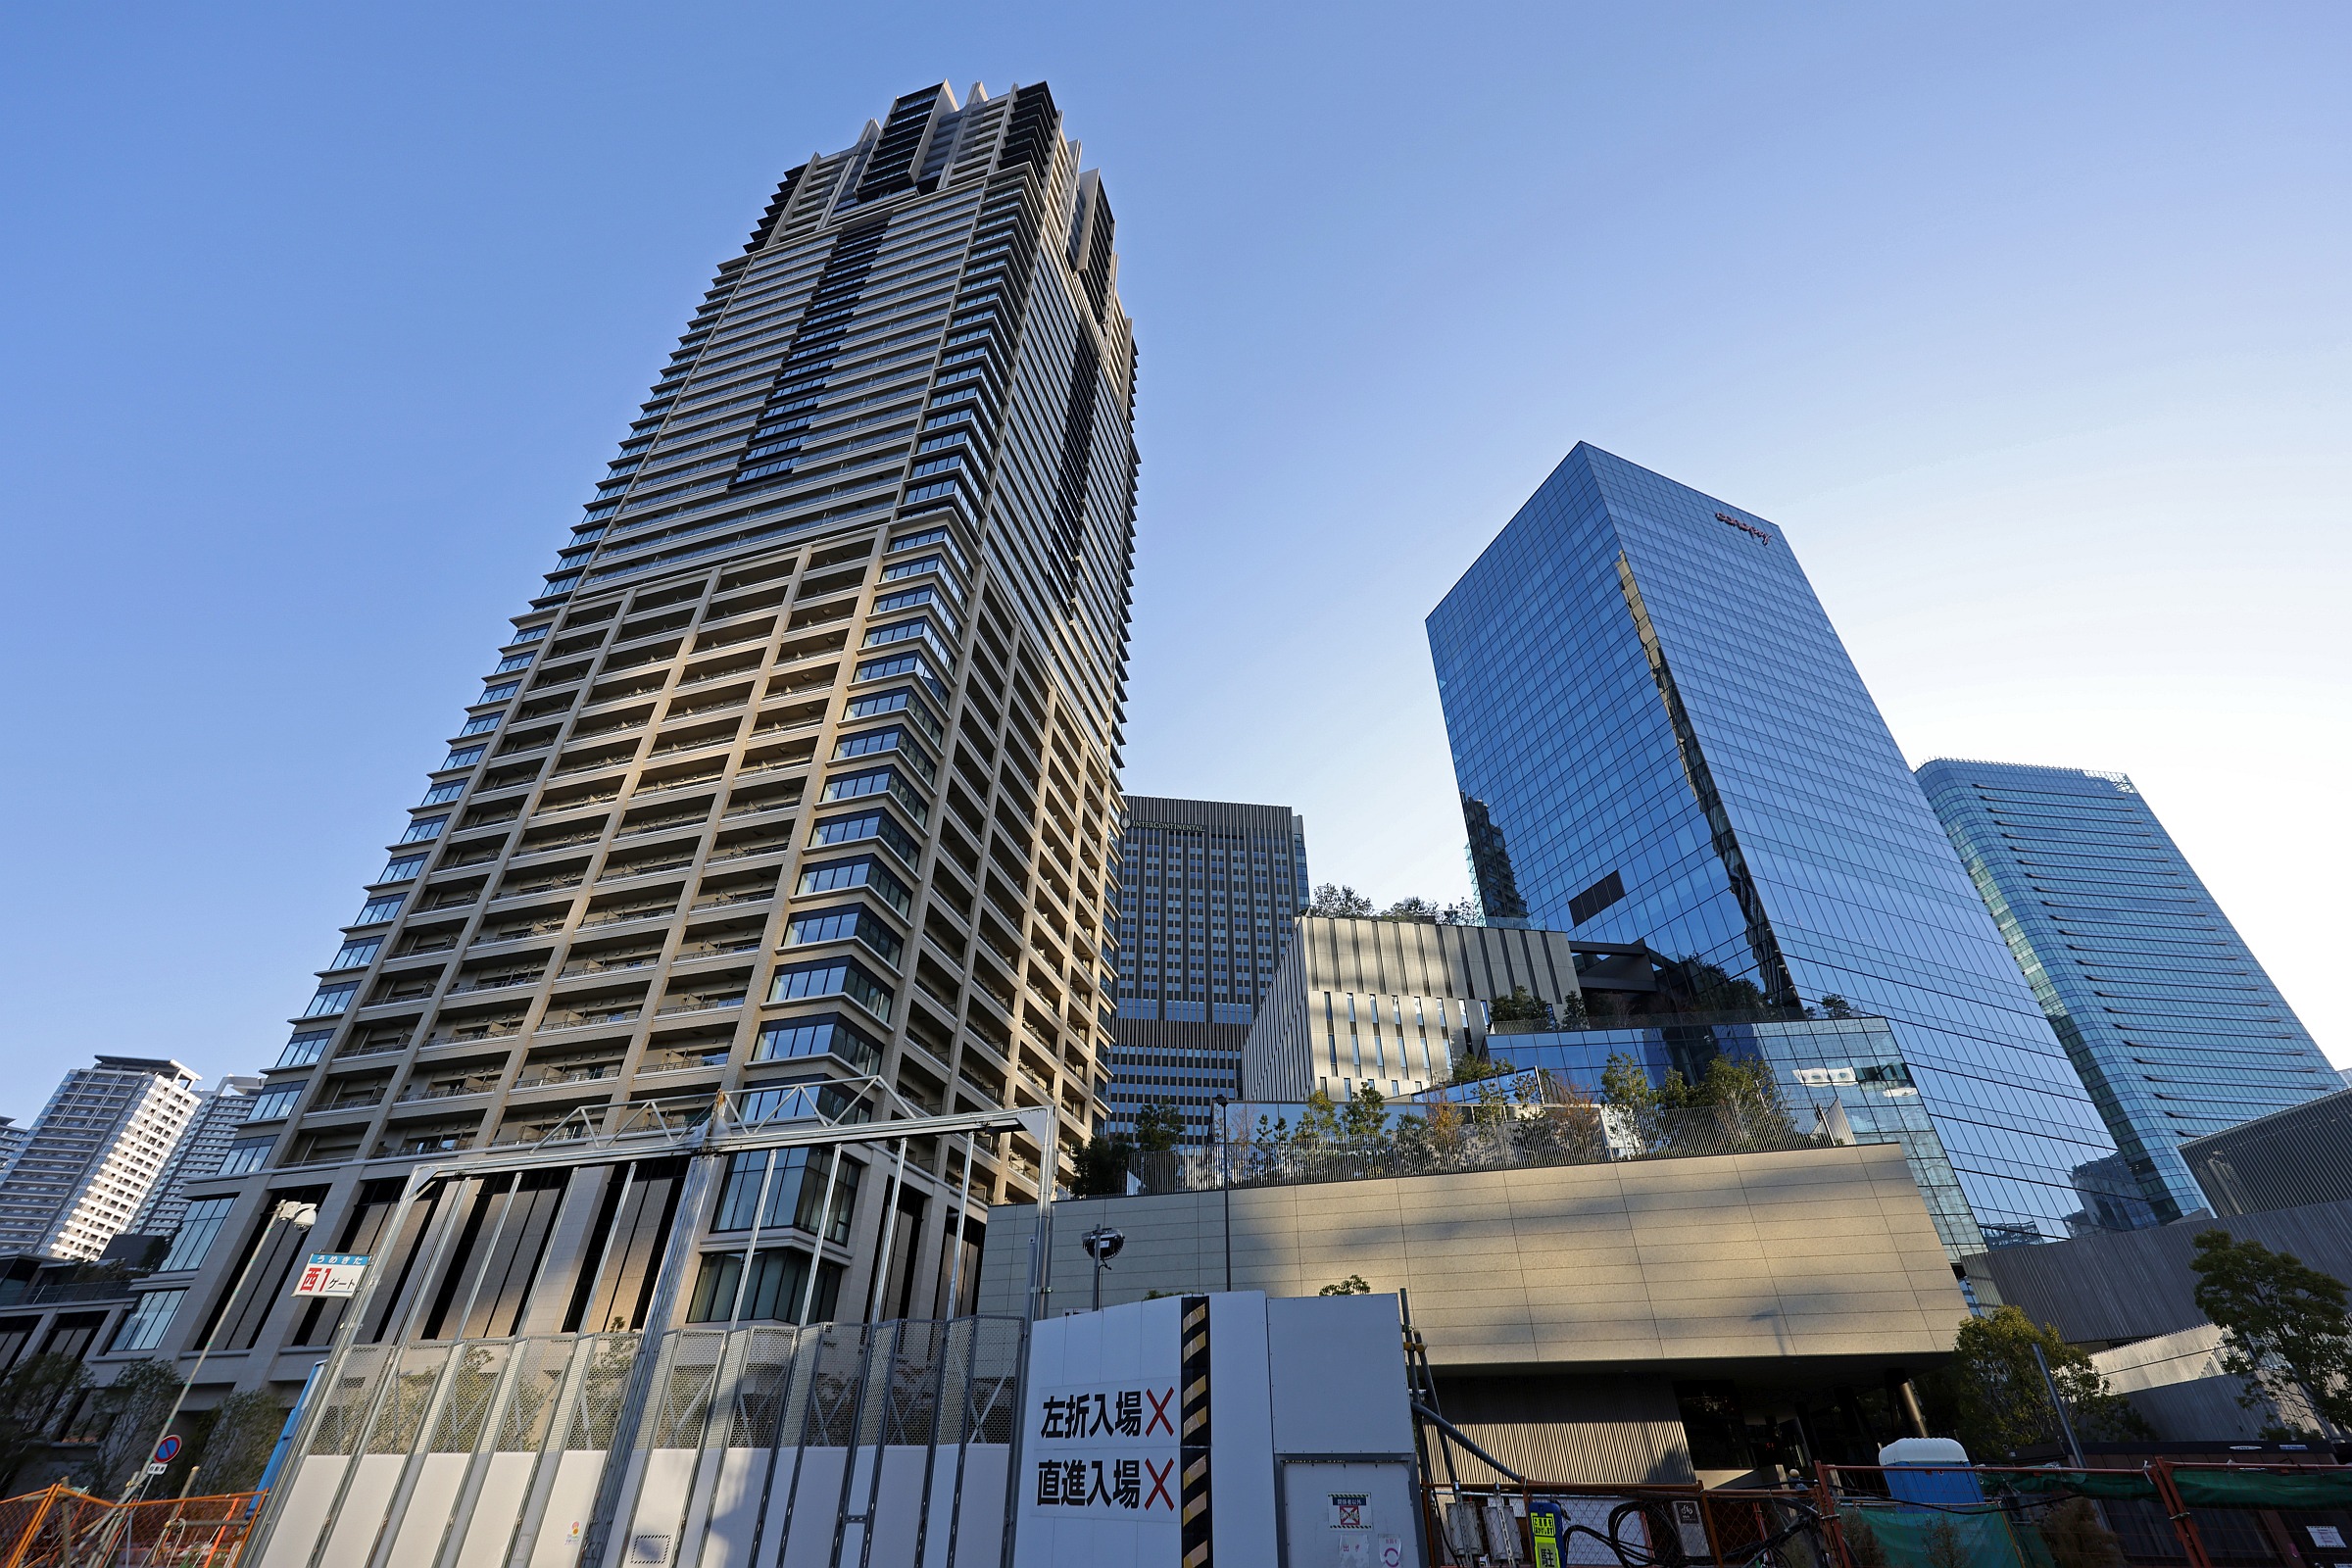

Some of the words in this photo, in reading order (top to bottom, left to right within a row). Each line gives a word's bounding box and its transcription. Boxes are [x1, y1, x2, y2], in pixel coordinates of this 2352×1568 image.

[317, 1255, 364, 1265] うめきた
[1041, 1391, 1142, 1439] 左折入場
[1037, 1459, 1141, 1509] 直進入場
